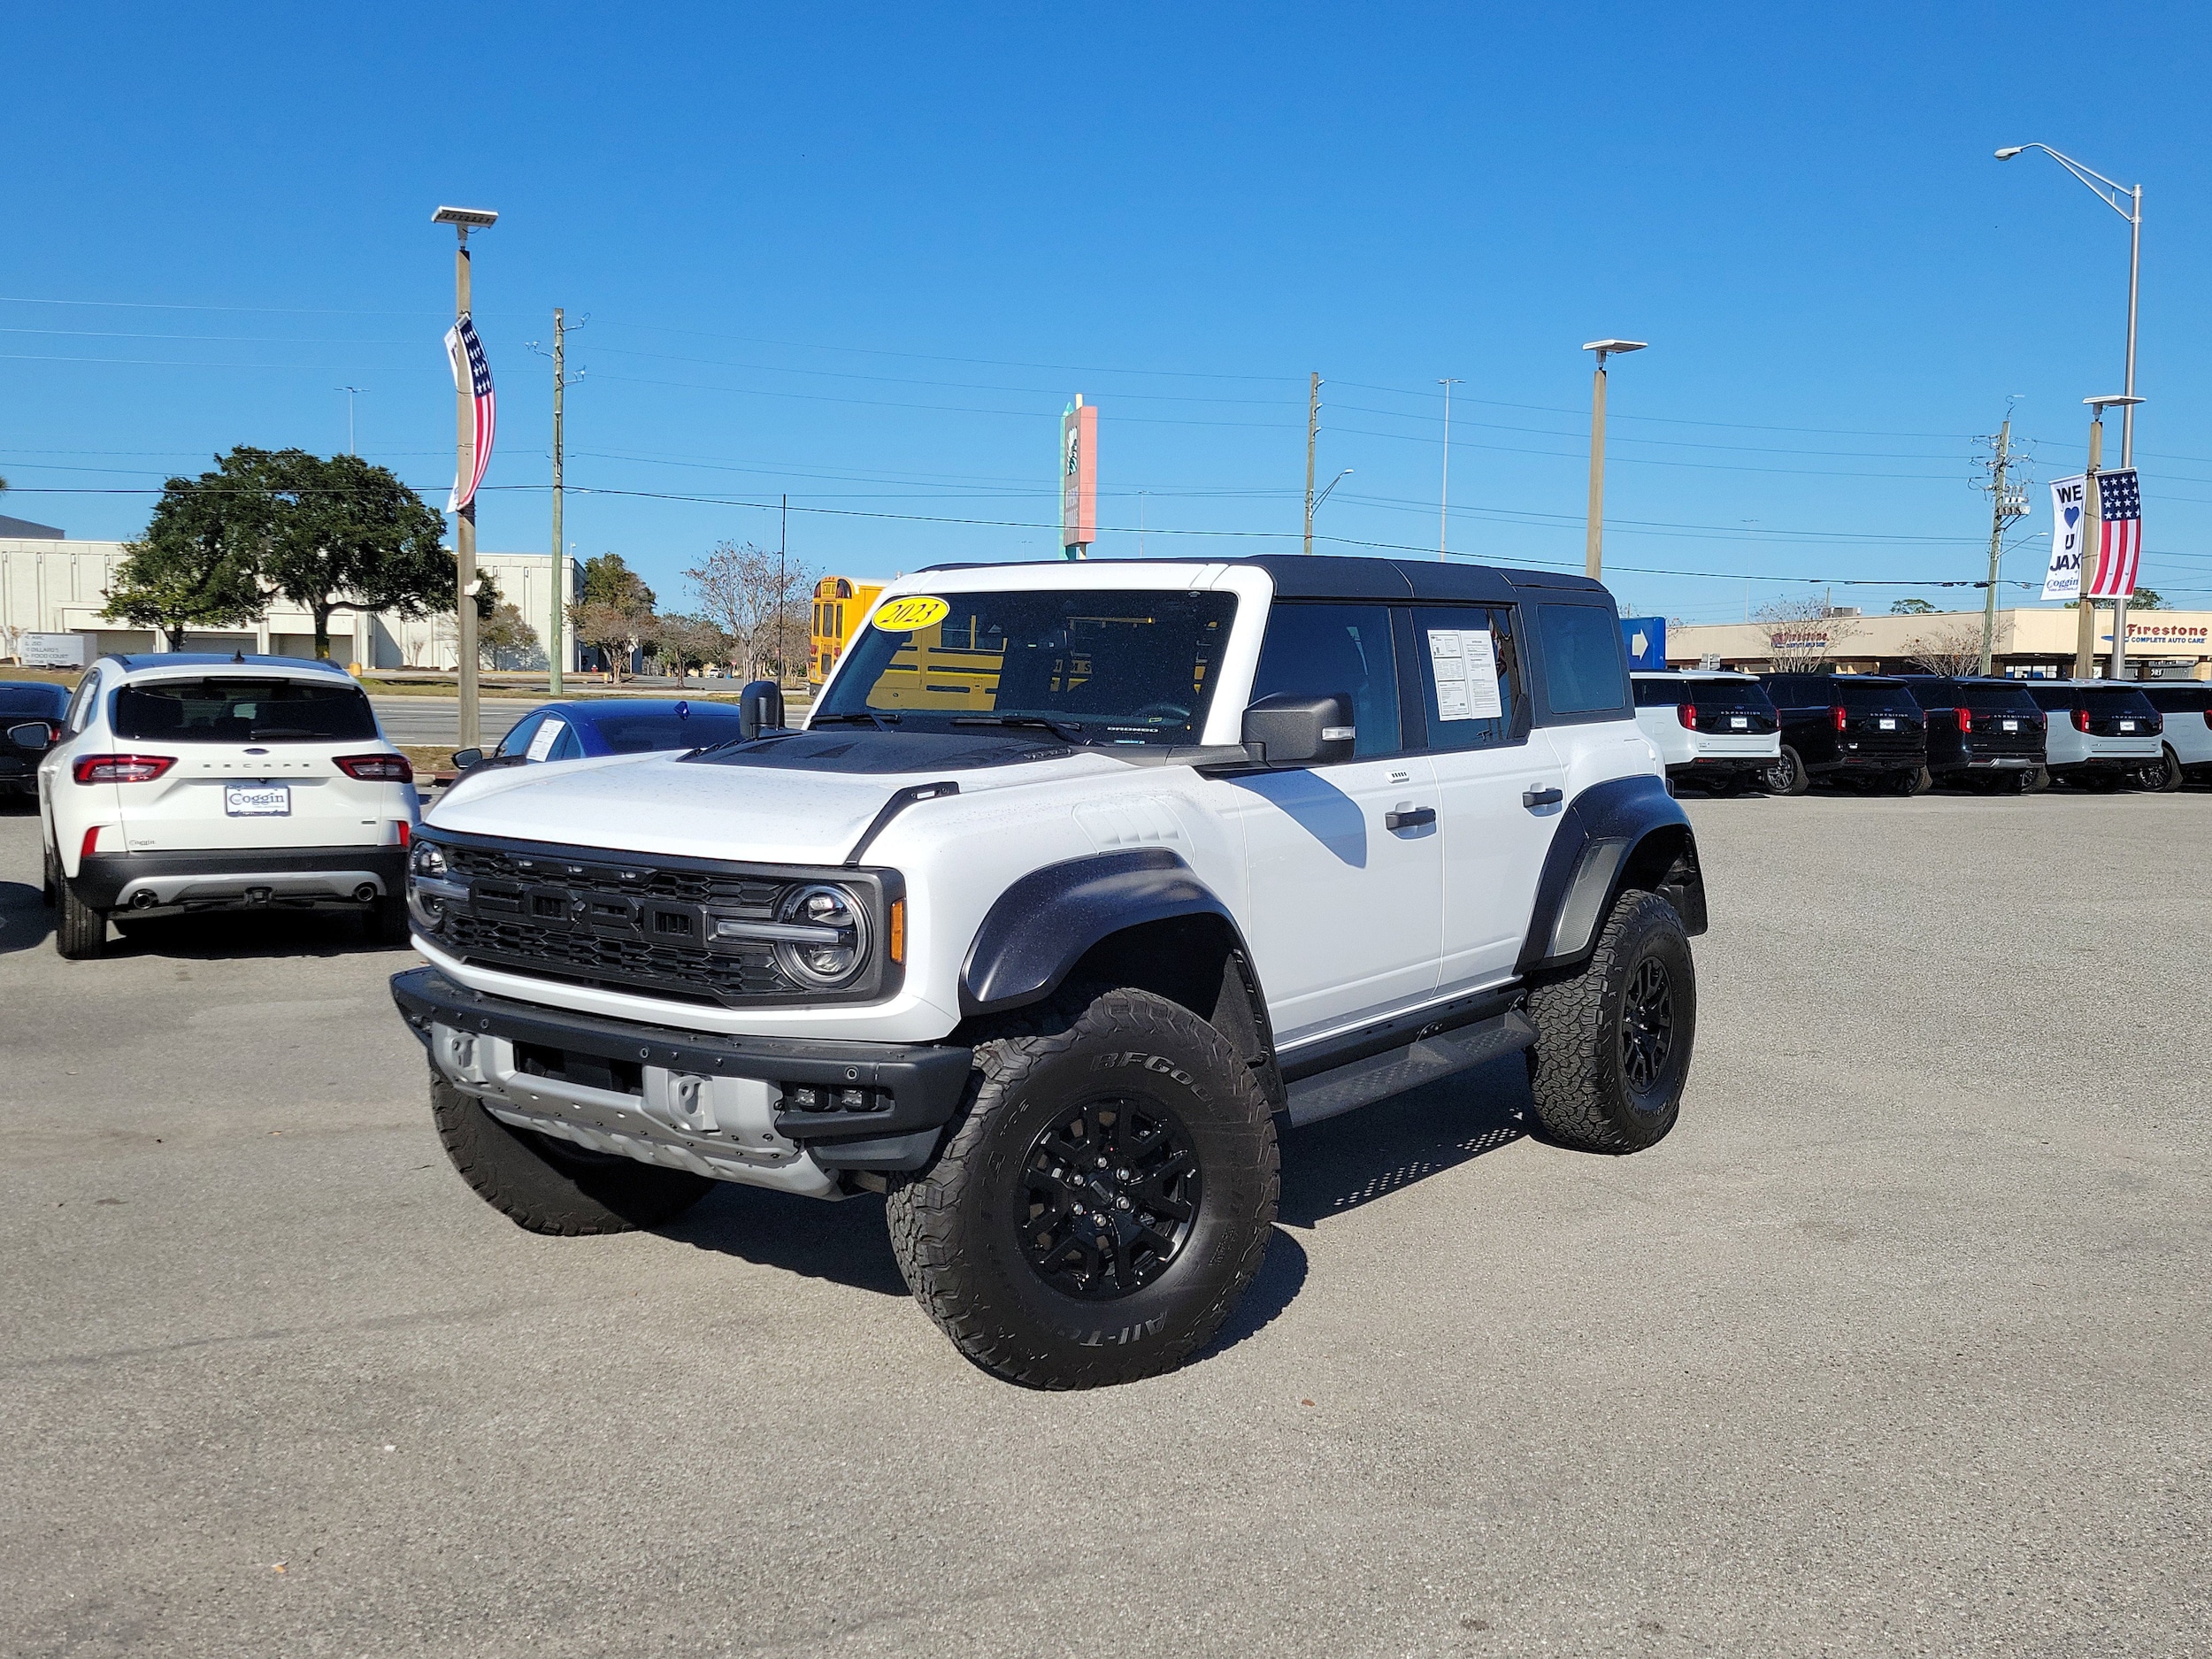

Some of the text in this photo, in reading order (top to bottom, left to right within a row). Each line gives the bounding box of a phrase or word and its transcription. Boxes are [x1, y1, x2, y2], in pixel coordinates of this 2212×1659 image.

[2056, 484, 2083, 503] WE
[2065, 534, 2075, 550] U
[2049, 553, 2082, 572] JAX
[2047, 577, 2078, 589] Coggin
[879, 603, 939, 623] 2023
[2126, 624, 2208, 637] Firestone
[229, 793, 285, 805] Coggin
